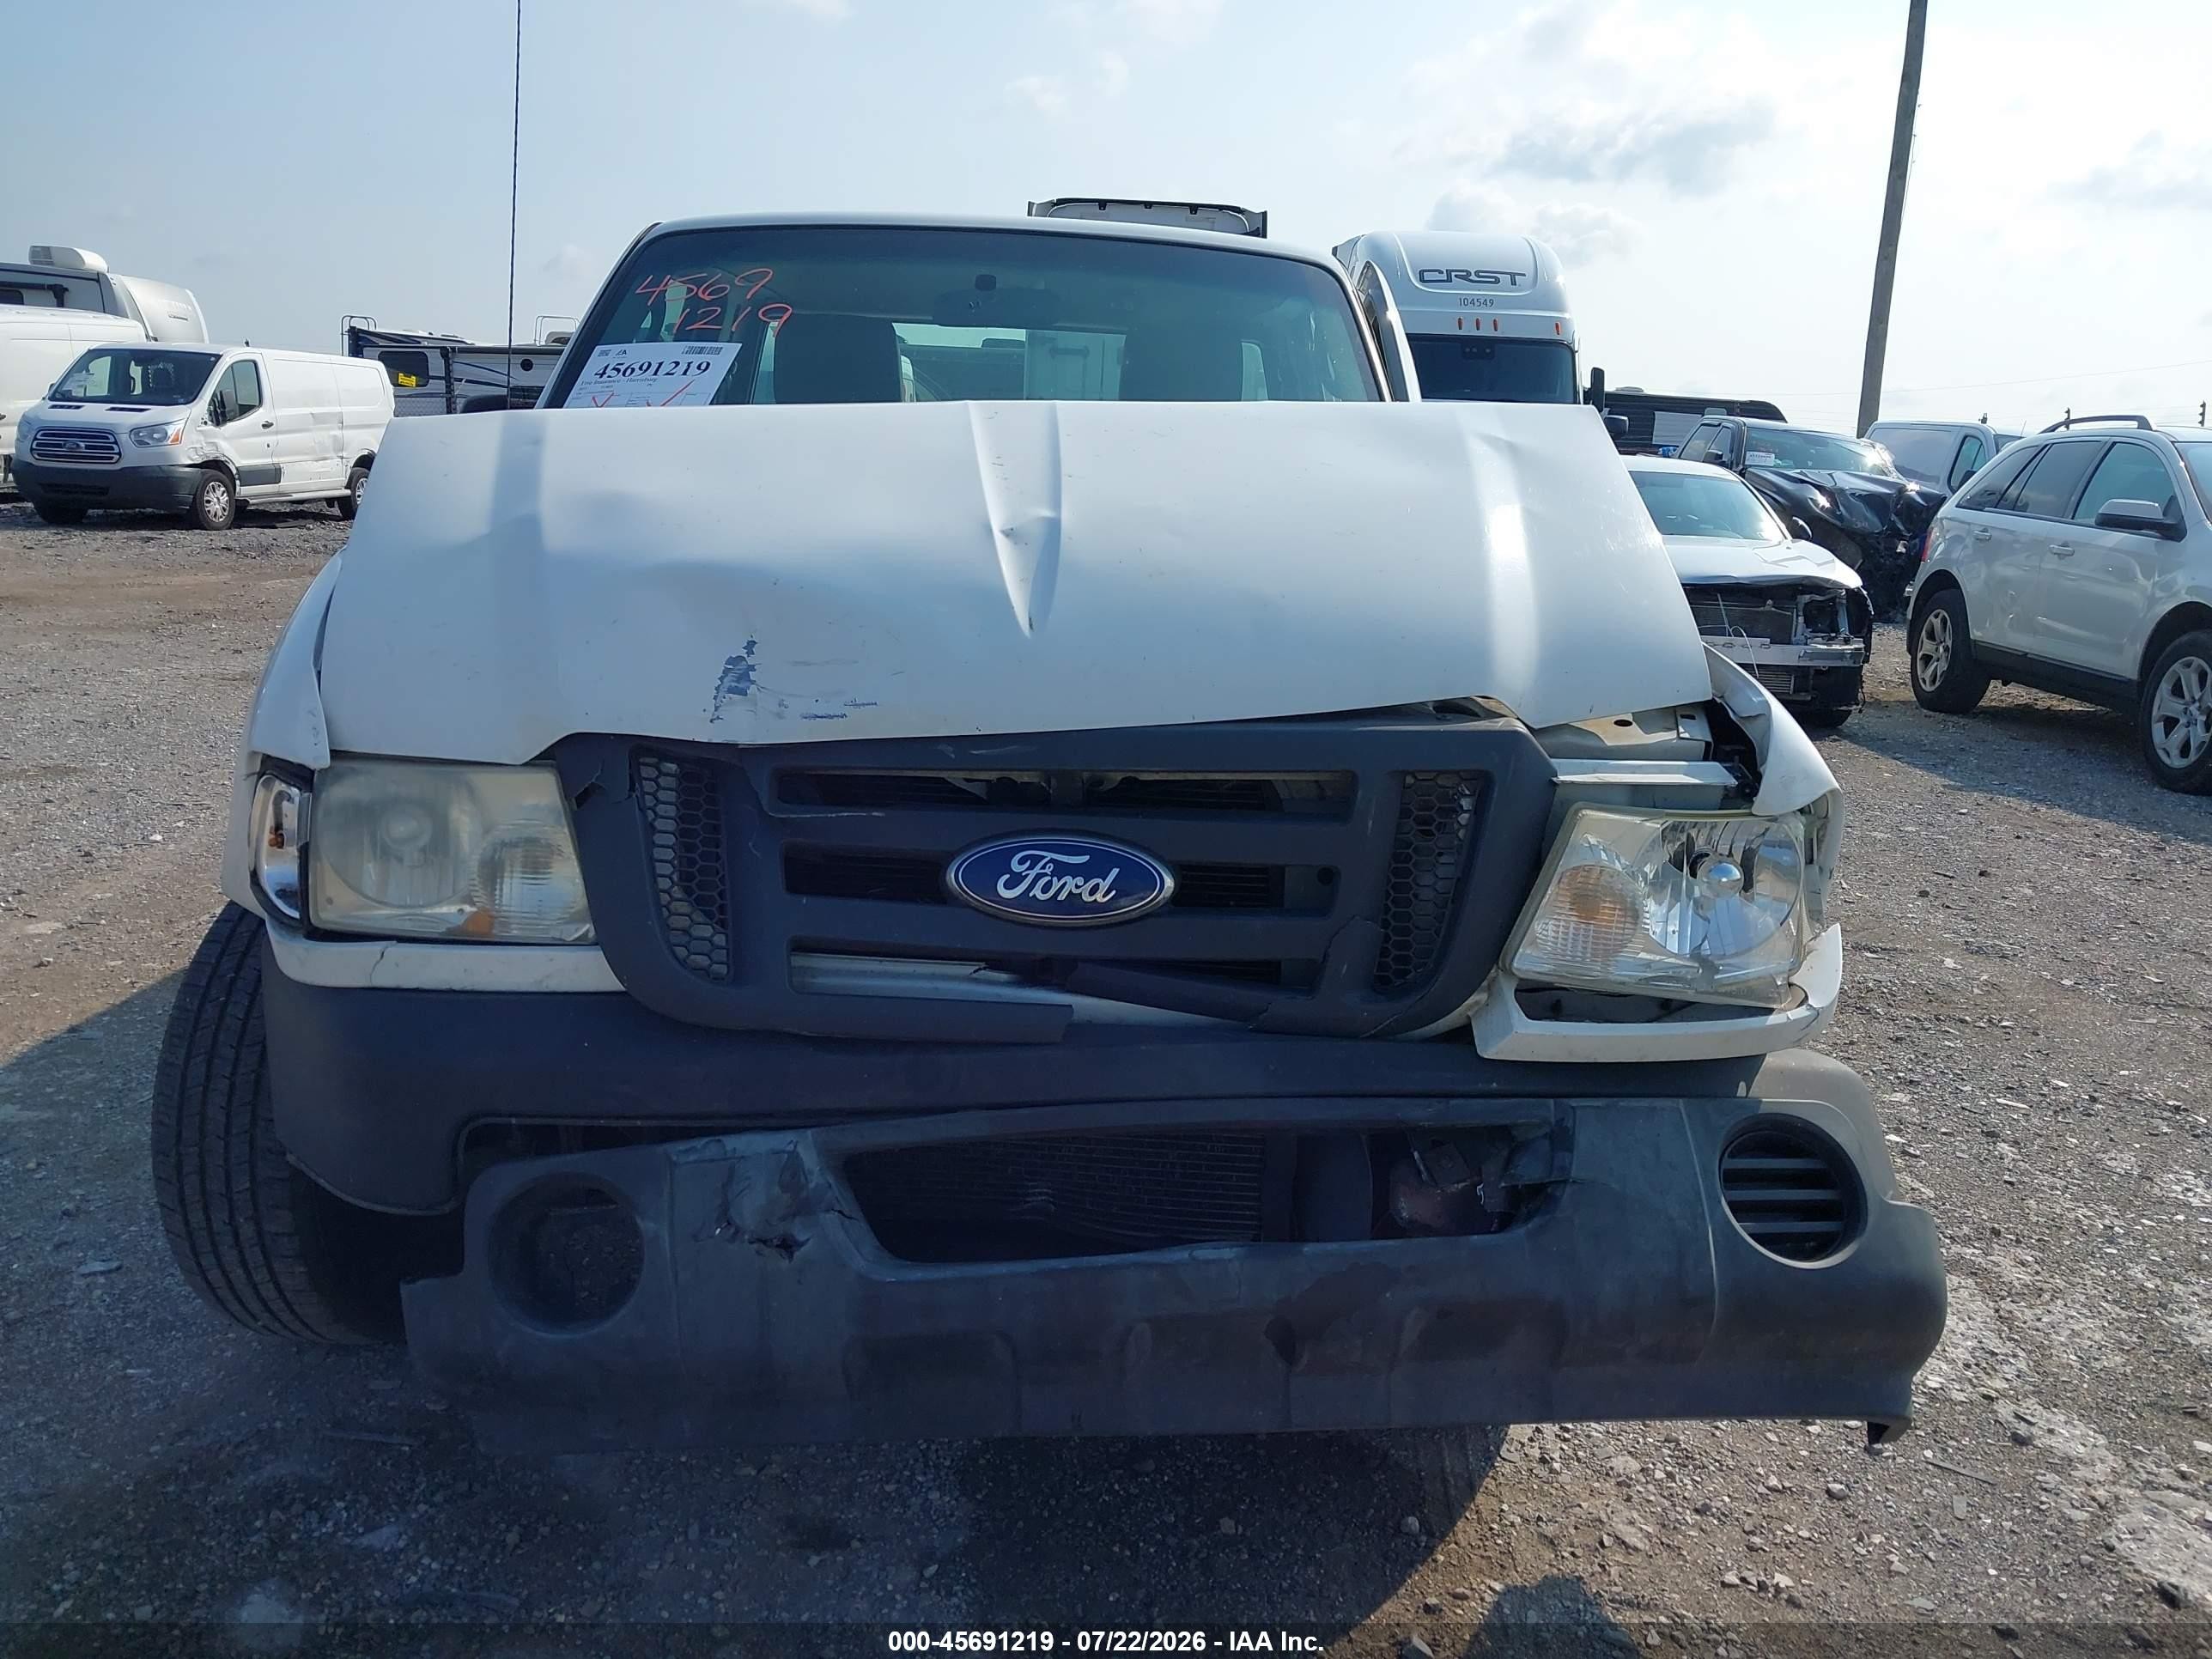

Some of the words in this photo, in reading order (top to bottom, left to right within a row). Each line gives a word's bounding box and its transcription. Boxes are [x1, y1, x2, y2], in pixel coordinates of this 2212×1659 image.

[635, 268, 773, 307] 4569
[1419, 268, 1527, 286] CRST
[1459, 297, 1494, 307] 104549
[672, 303, 792, 338] 1219
[594, 361, 711, 379] 45691219
[997, 849, 1120, 902] Ford
